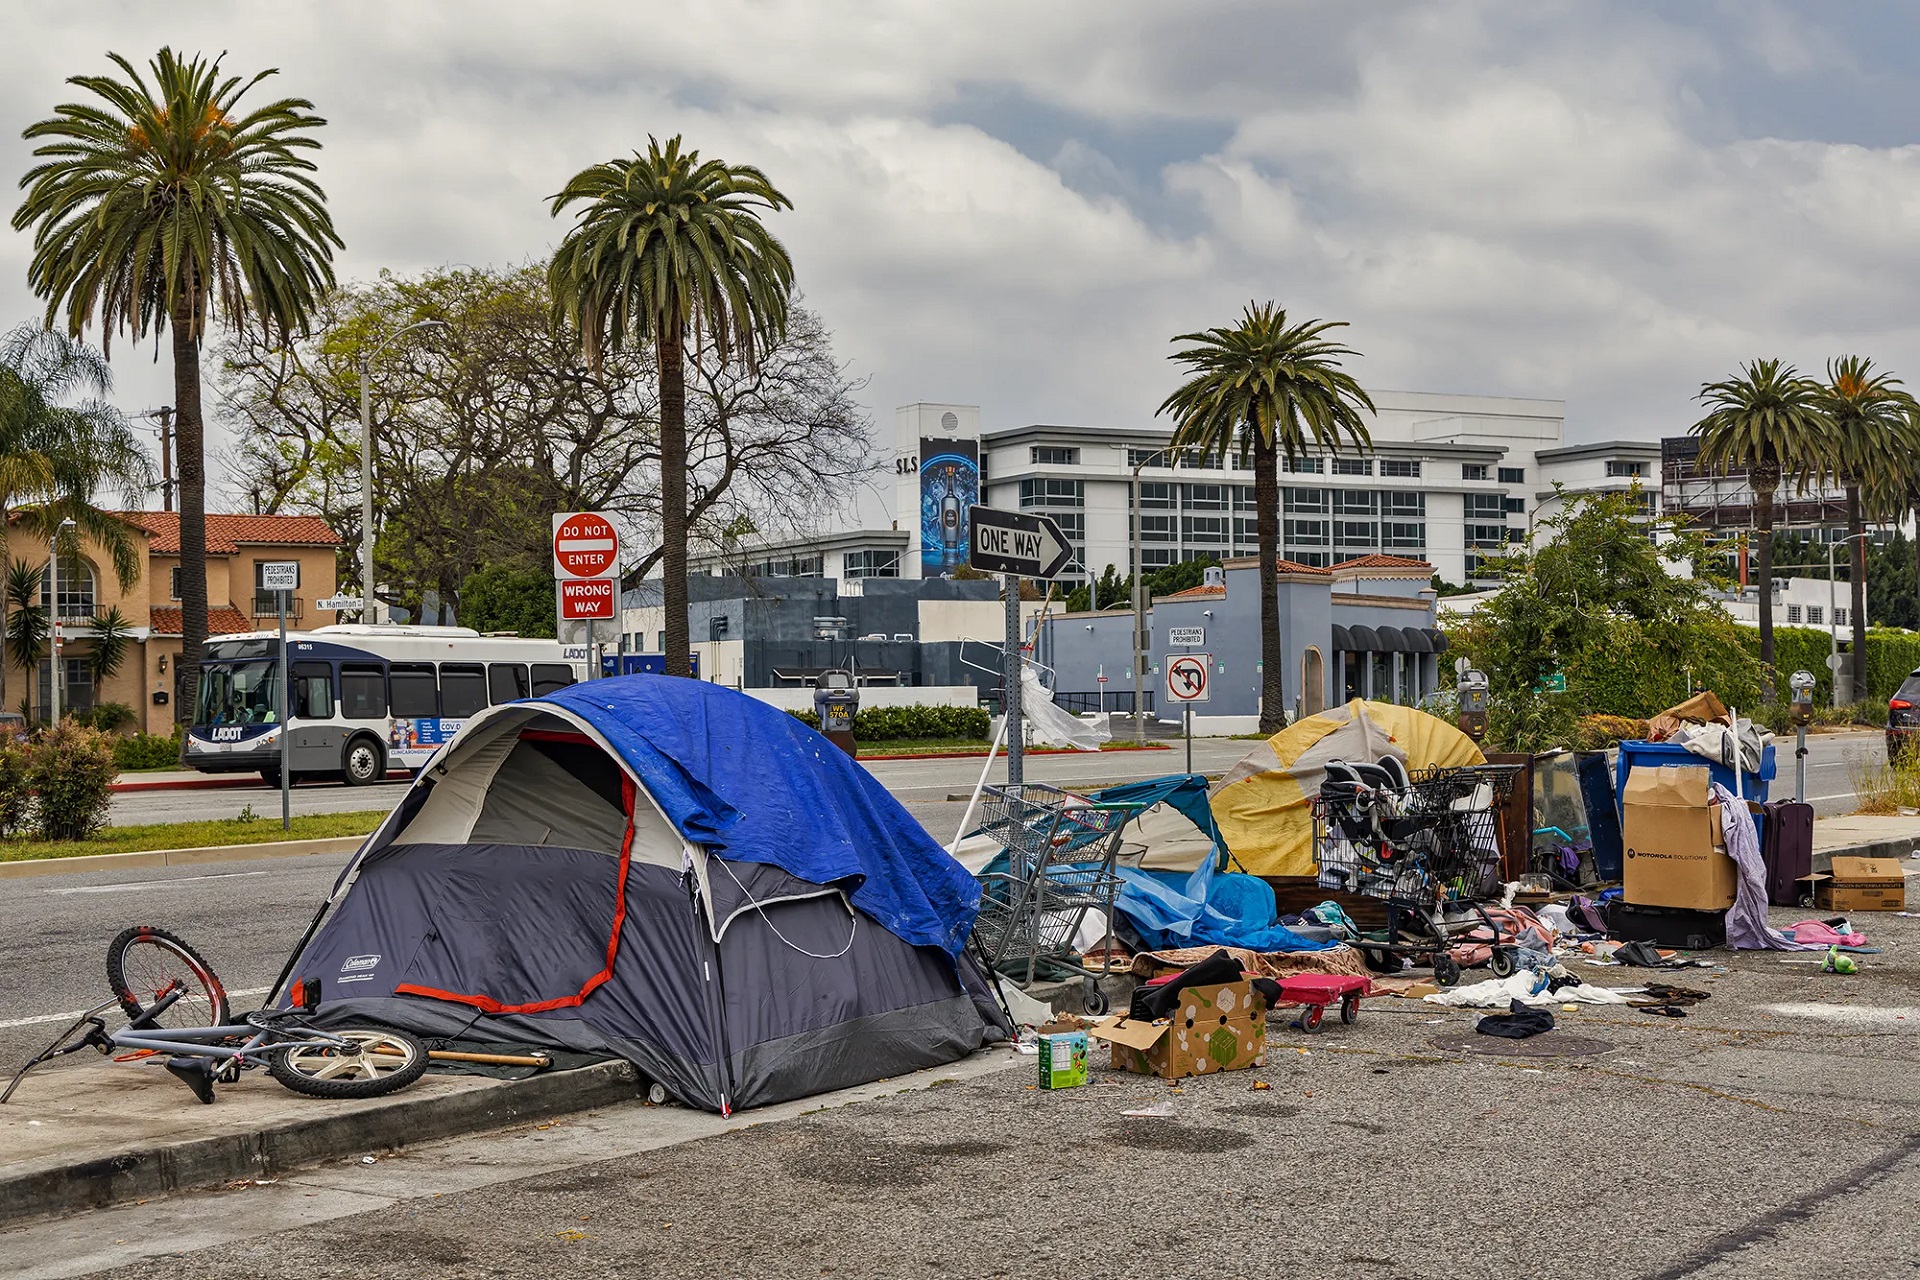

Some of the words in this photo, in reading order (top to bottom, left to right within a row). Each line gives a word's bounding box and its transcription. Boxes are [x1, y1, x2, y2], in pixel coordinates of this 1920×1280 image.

[896, 456, 918, 474] SLS
[563, 526, 579, 537] DO
[584, 525, 608, 536] NOT
[980, 528, 1009, 554] ONE
[1014, 532, 1042, 558] WAY
[568, 554, 605, 565] ENTER
[265, 565, 295, 574] PEDESTRIANS
[267, 575, 293, 584] PROHIBITED
[564, 585, 611, 597] WRONG
[326, 600, 357, 609] Hamilton
[574, 601, 601, 613] WAY
[1170, 628, 1202, 636] PEDESTRIANS
[441, 723, 462, 731] COVD
[211, 727, 243, 740] LADOT
[1637, 852, 1673, 860] MOTOROLA
